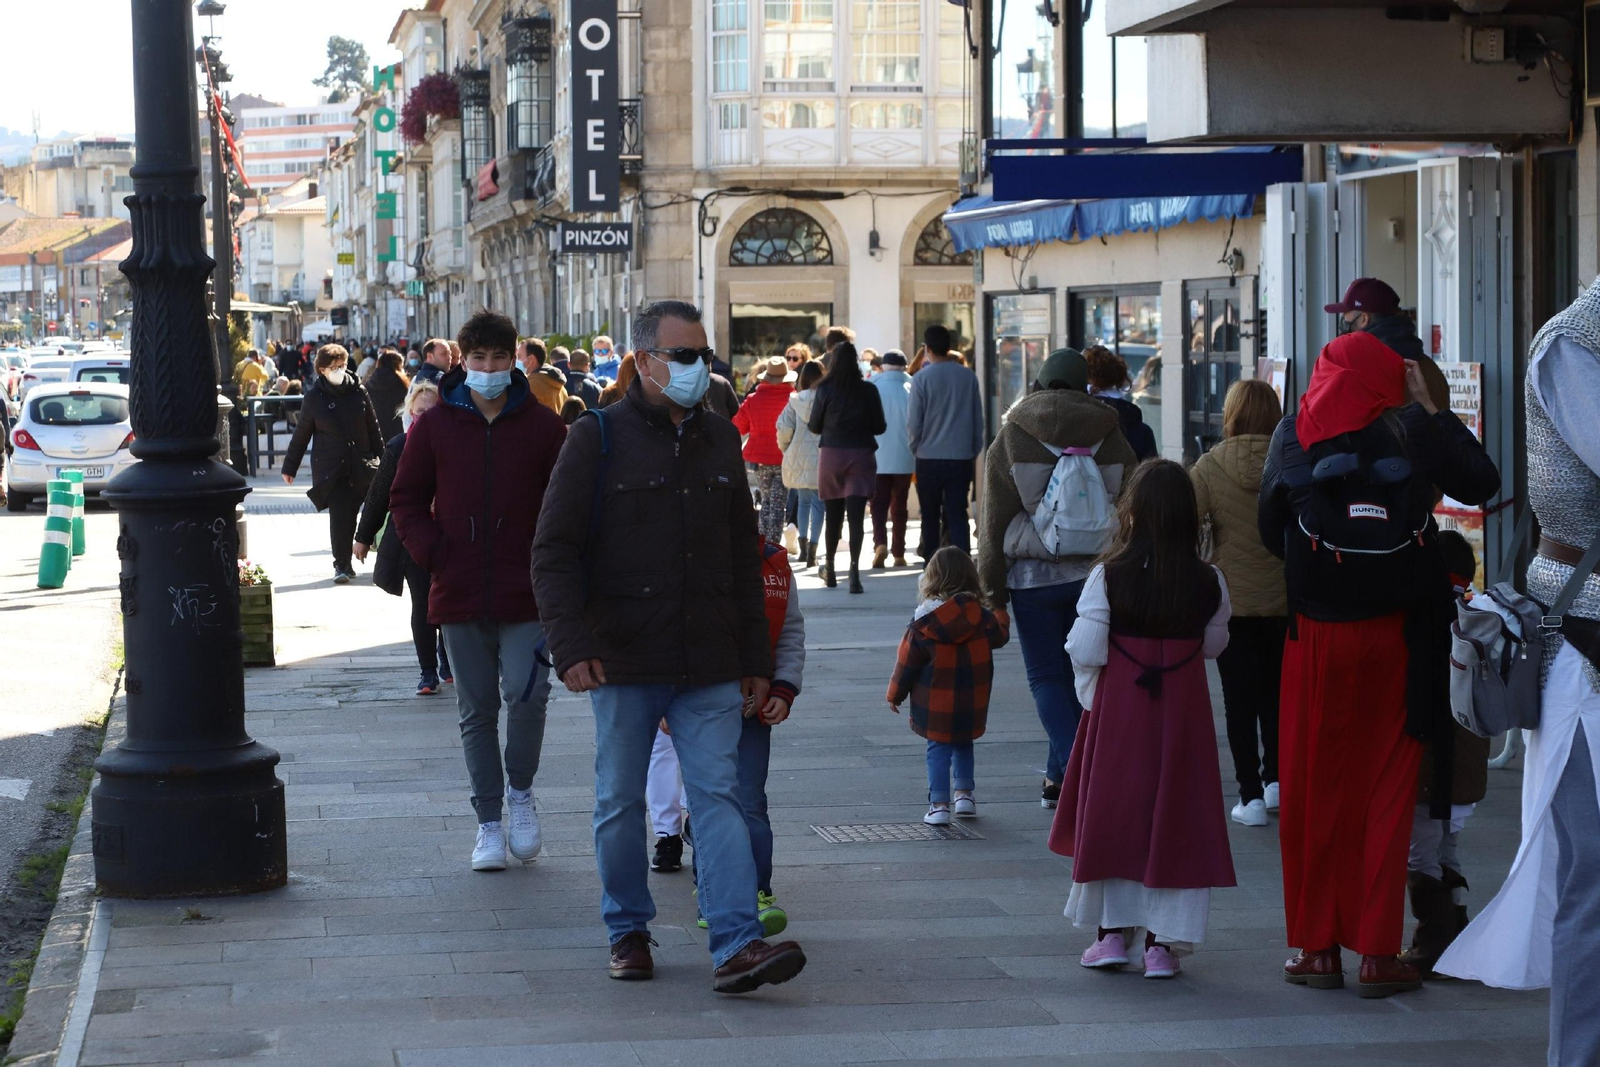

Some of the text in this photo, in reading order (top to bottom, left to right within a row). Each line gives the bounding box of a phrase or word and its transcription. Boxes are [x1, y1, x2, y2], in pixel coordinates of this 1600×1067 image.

[578, 17, 611, 201] OTEL
[565, 226, 629, 246] PINZÓN
[1472, 385, 1478, 394] Y
[1450, 399, 1478, 409] ASERAS
[86, 467, 102, 476] GTH
[1351, 507, 1386, 516] HUNTER
[763, 575, 787, 587] LEVI
